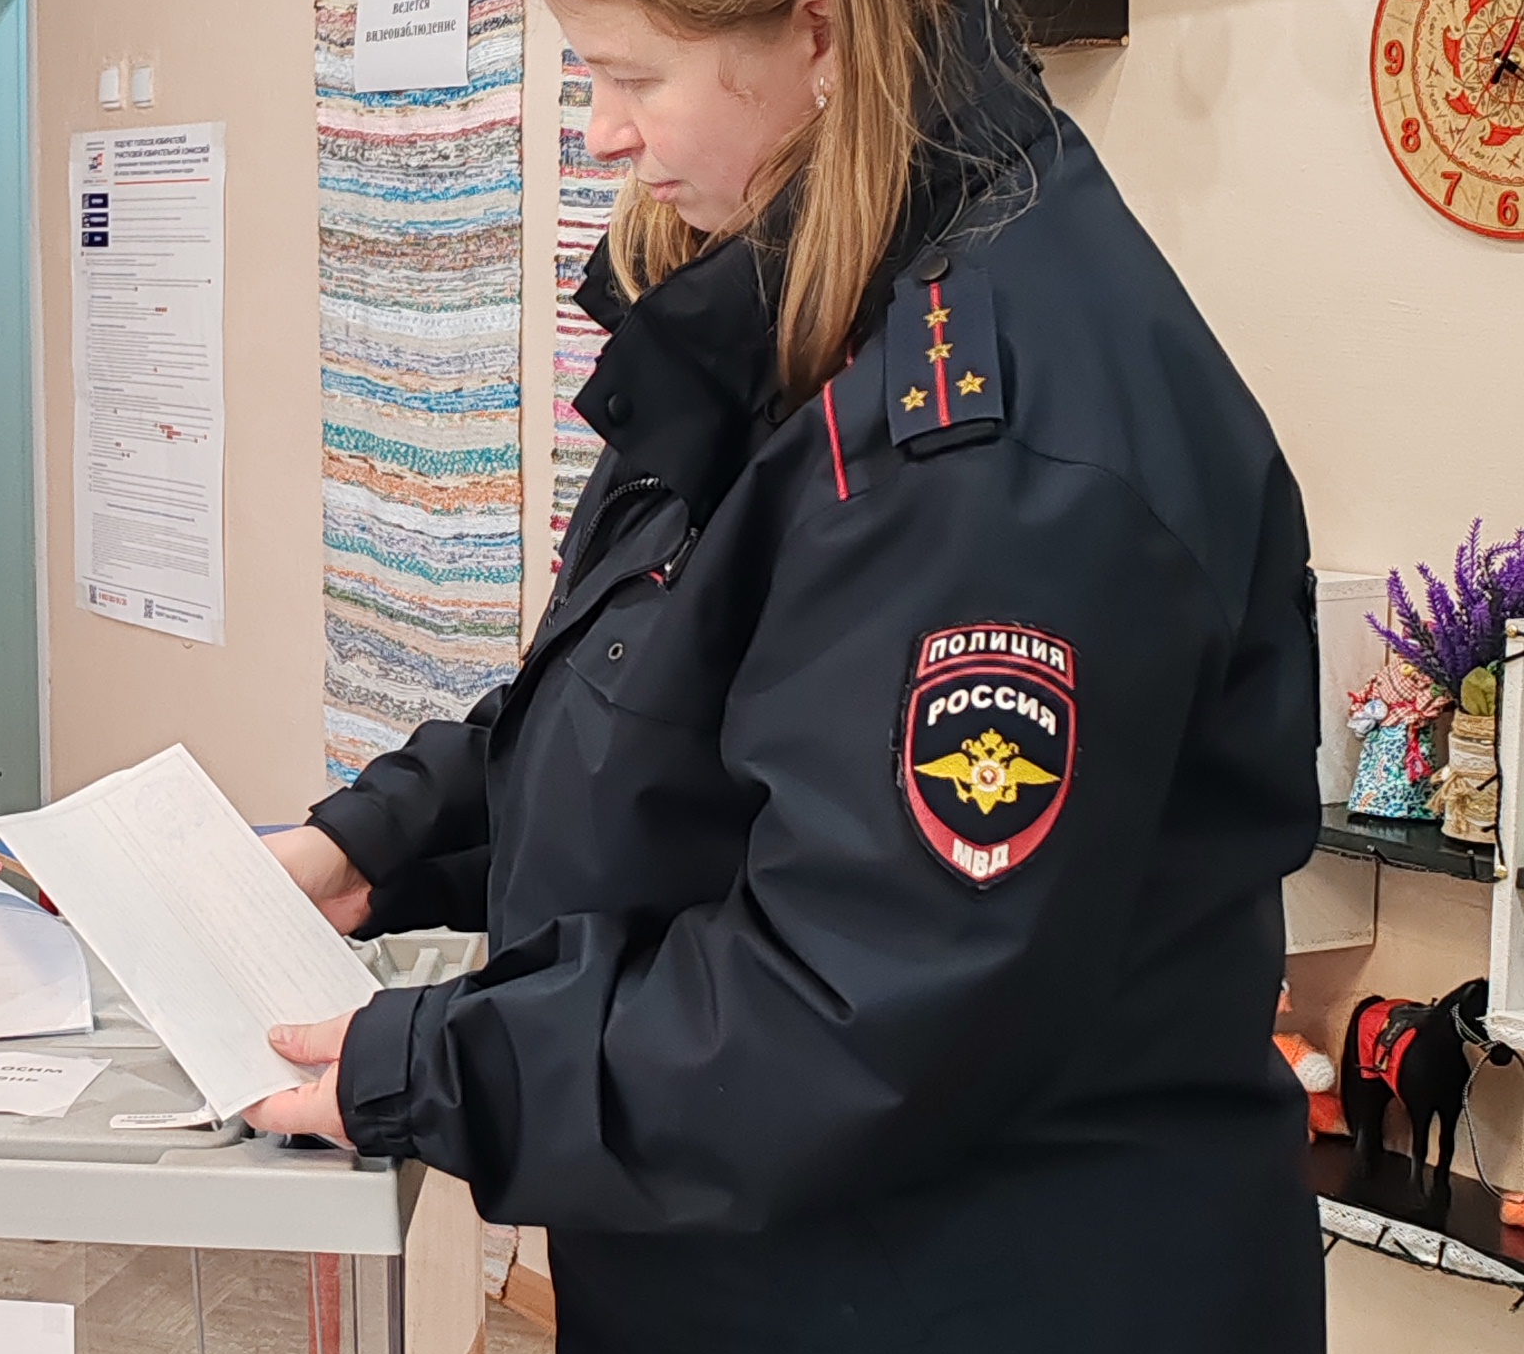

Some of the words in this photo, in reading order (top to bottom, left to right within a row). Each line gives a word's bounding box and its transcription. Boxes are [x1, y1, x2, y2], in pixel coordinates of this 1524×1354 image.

[366, 20, 456, 42] видеонаблюдение
[1384, 39, 1405, 77] 9
[1400, 117, 1421, 153] 8
[1440, 170, 1463, 206] 7
[1497, 189, 1519, 227] 6
[928, 631, 1066, 672] ПОЛИЦИЯ
[927, 685, 1058, 737] РОССИЯ
[952, 838, 1010, 878] МВД
